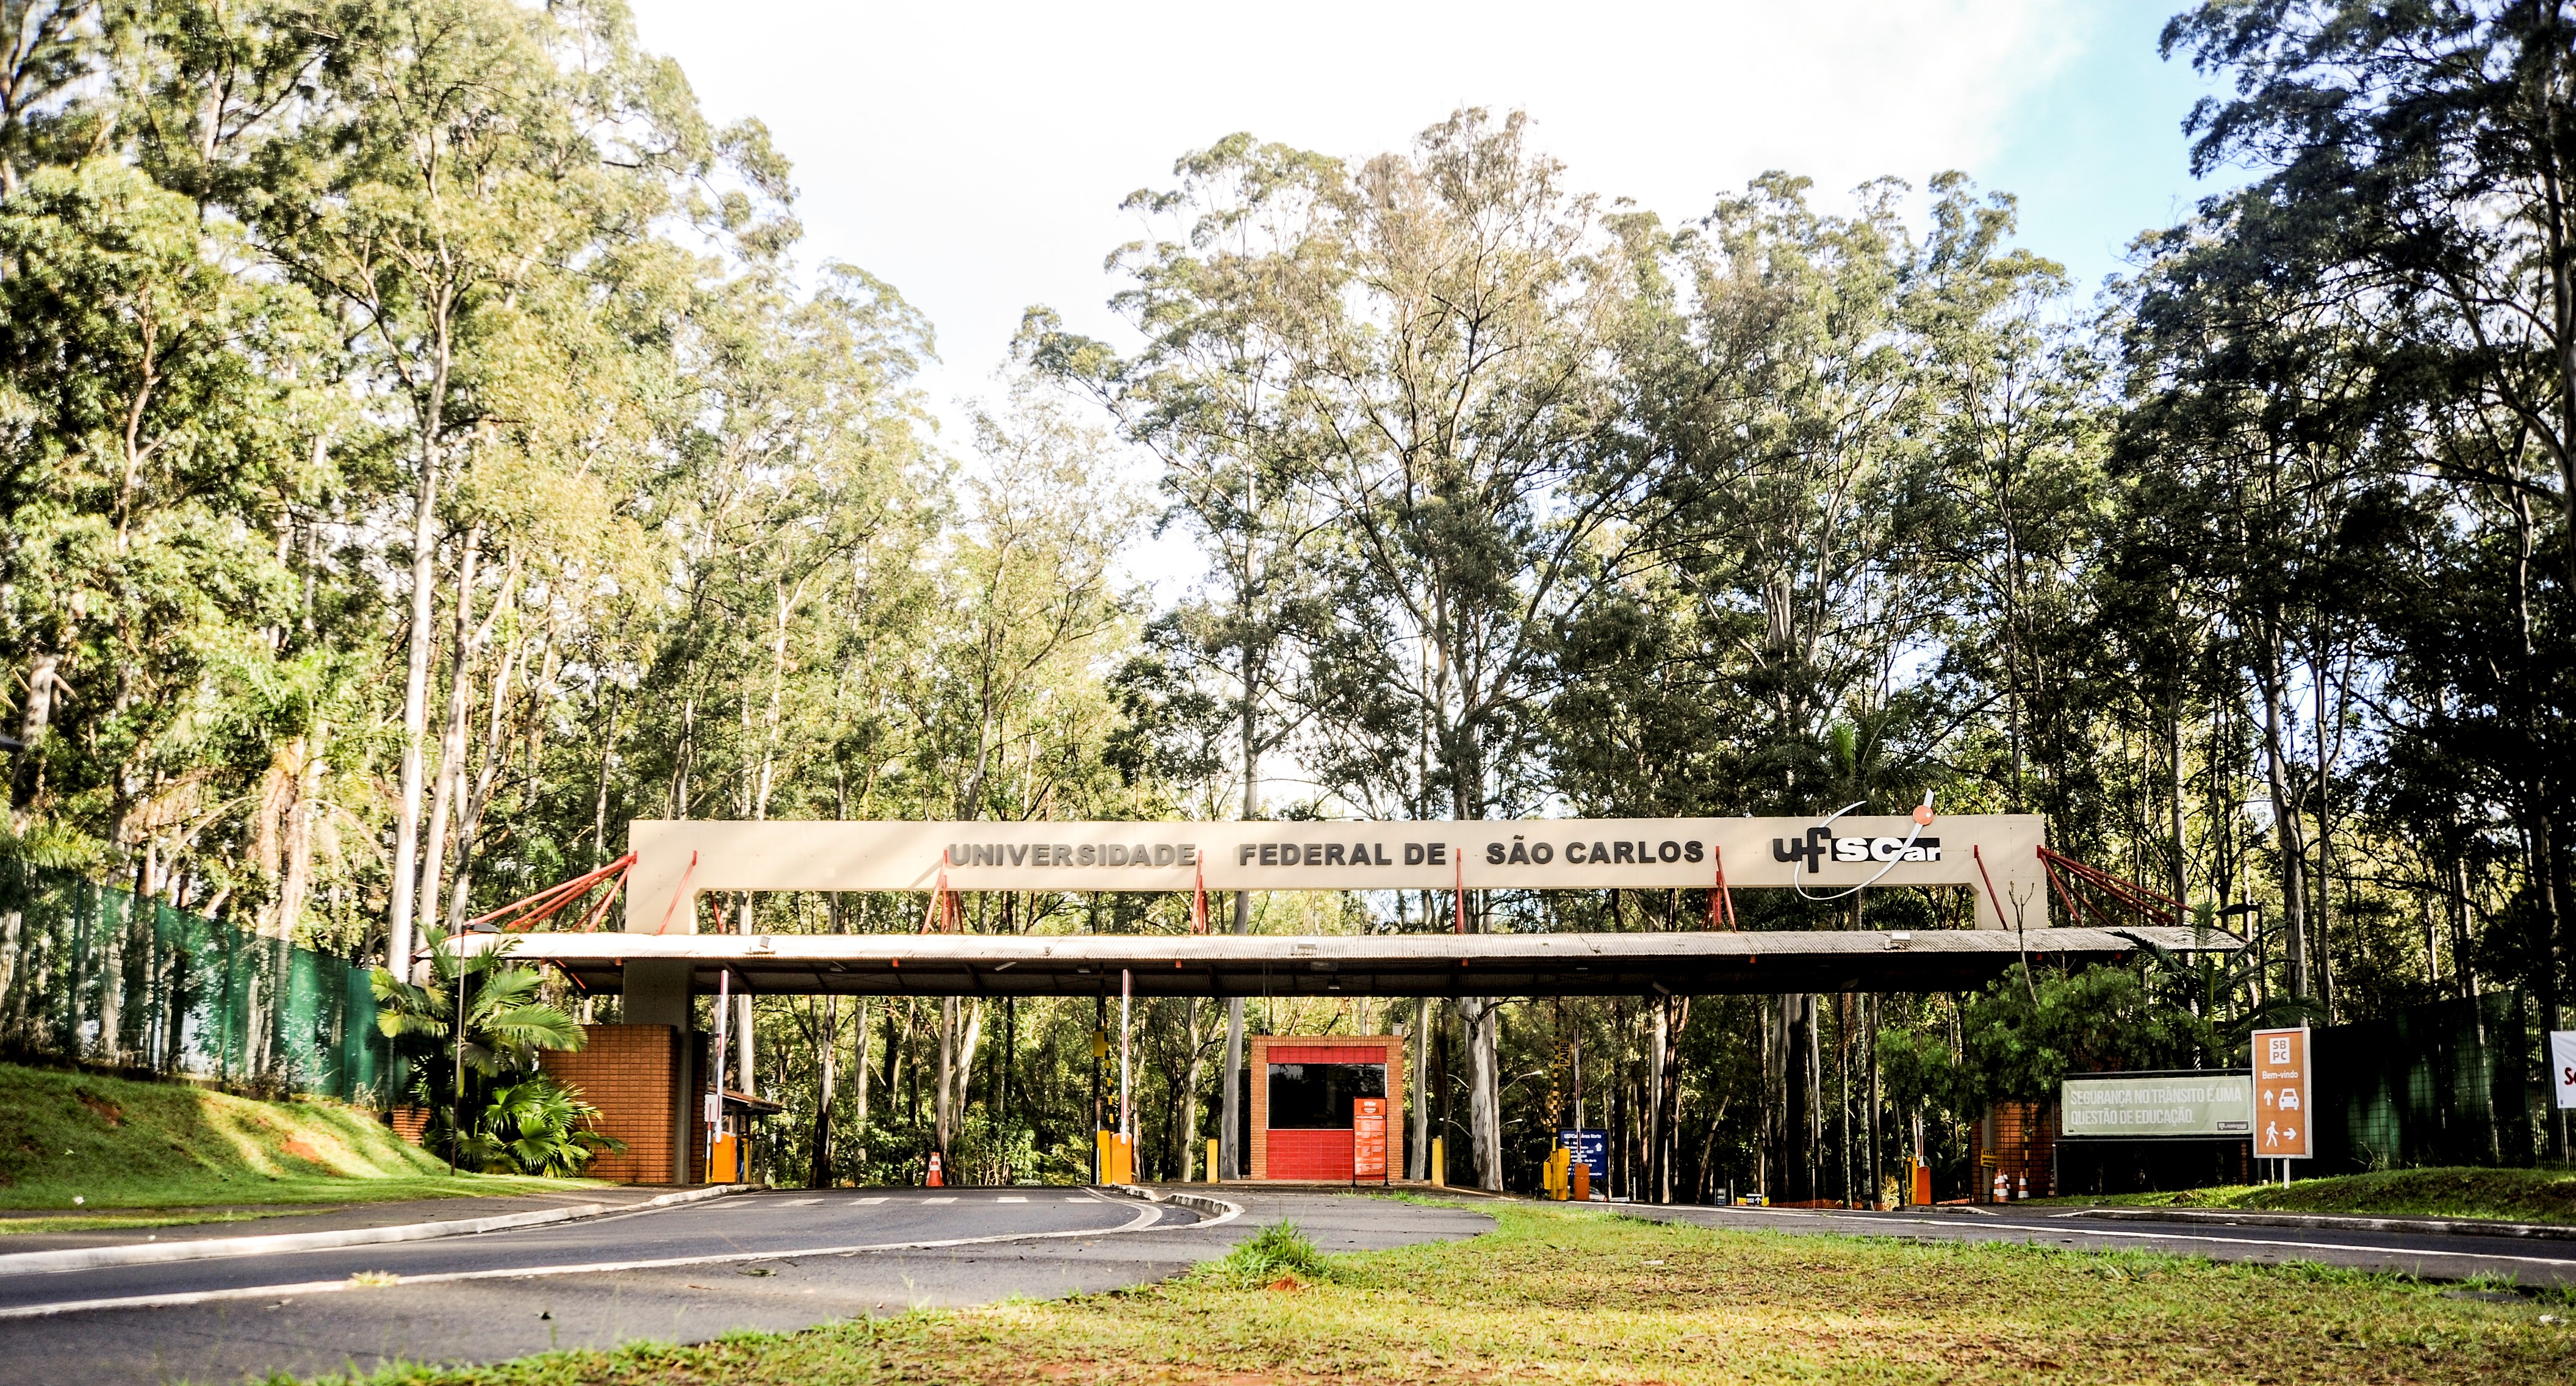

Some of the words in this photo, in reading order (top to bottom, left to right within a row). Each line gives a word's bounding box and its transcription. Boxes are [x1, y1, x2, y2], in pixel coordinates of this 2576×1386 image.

[949, 843, 1196, 866] UNIVERSIDADE
[1240, 843, 1392, 865] FEDERAL
[1405, 843, 1446, 865] DE
[1486, 835, 1553, 864] SÃO
[1566, 841, 1704, 864] CARLOS
[1560, 1042, 1570, 1064] PARE
[2273, 1041, 2286, 1049] SB
[2273, 1051, 2286, 1061] PC
[2262, 1070, 2298, 1080] Bem-vindo
[2070, 1089, 2132, 1106] SEGURANÇA
[2135, 1089, 2150, 1104] NO
[2151, 1086, 2204, 1103] TRÂNSITO
[2206, 1085, 2214, 1102] É
[2216, 1087, 2242, 1102] UMA
[2071, 1108, 2118, 1125] QUESTÃO
[2120, 1110, 2134, 1124] DE
[2137, 1106, 2195, 1127] EDUCAÇÃO.
